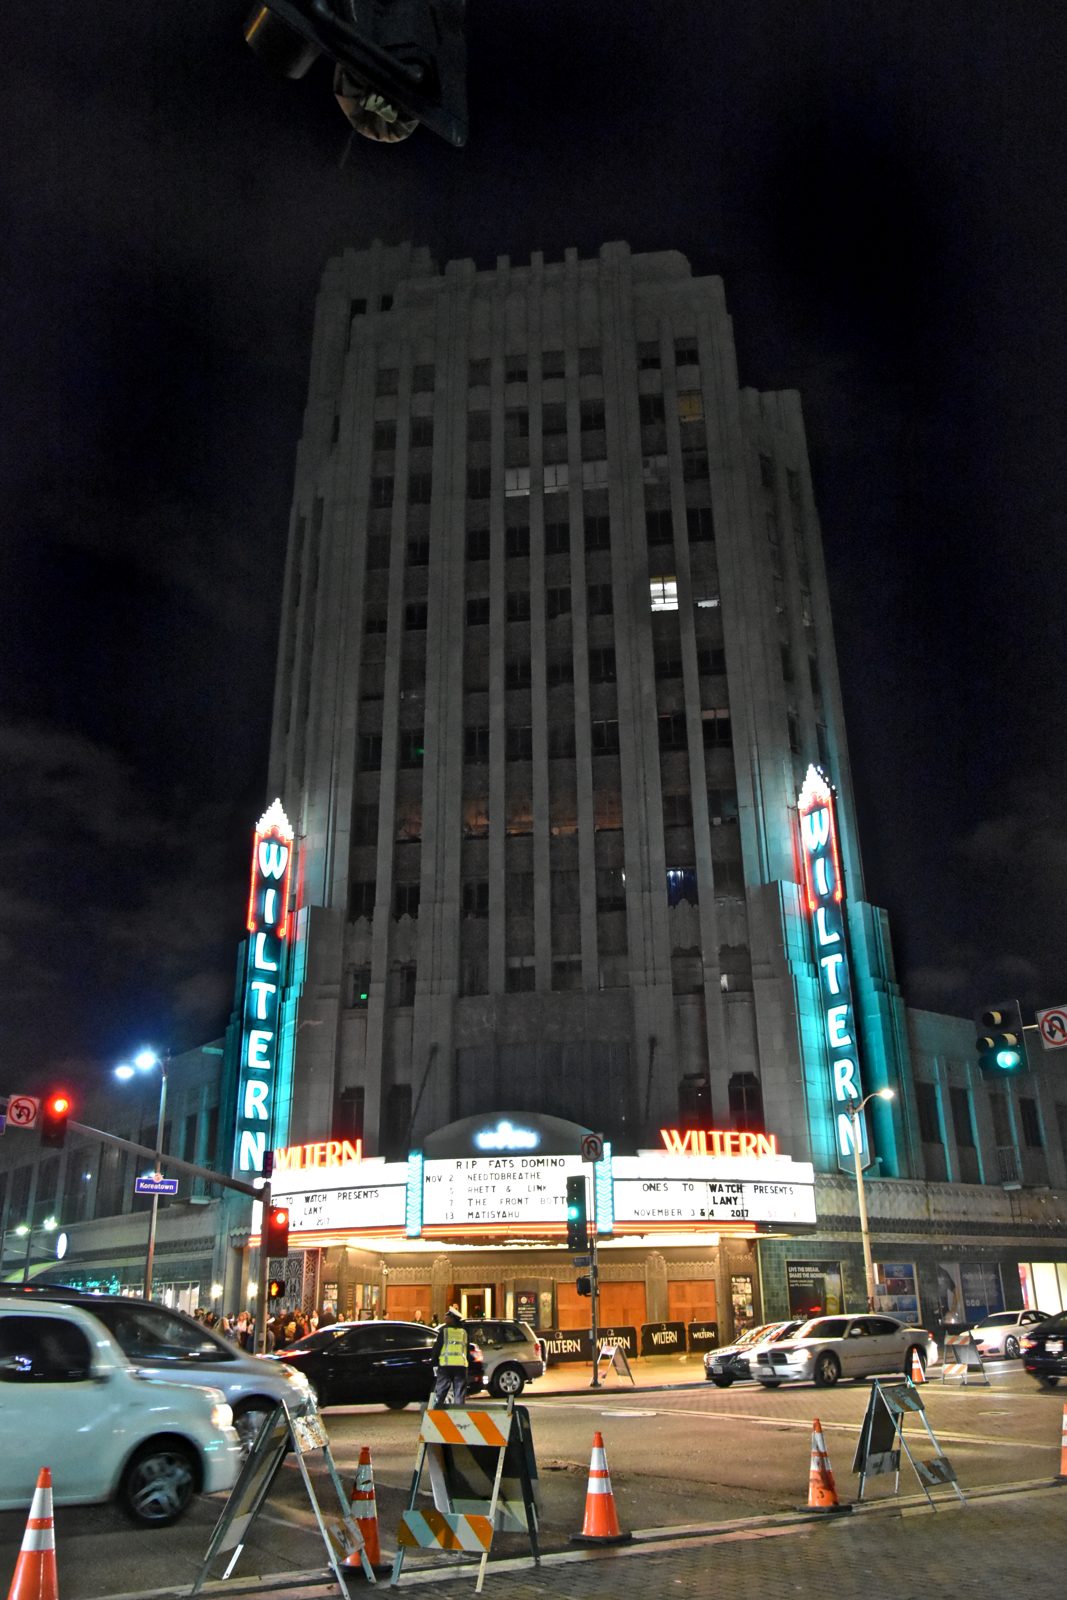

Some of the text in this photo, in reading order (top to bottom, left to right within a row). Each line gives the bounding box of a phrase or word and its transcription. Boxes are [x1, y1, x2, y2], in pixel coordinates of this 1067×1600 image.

[803, 807, 863, 1156] WILTERN
[239, 842, 288, 1172] WILTERN
[660, 1129, 776, 1158] WILTERN
[456, 1158, 566, 1170] RIP FATS DOMINO
[426, 1175, 443, 1183] NOV
[468, 1172, 541, 1181] NEEDTOBREATHE
[139, 1182, 174, 1190] Koreatown
[506, 1185, 511, 1193] &
[642, 1183, 794, 1195] ONES TO WATCH PRESENTS
[304, 1195, 327, 1203] WATCH
[337, 1190, 380, 1200] PRESENTS
[468, 1198, 487, 1206] THE
[499, 1197, 529, 1205] FRONT
[540, 1196, 567, 1205] BOTT
[712, 1196, 738, 1205] LANY
[445, 1211, 520, 1220] 13 MATISYAHU
[633, 1209, 683, 1217] NOVEMBER
[700, 1209, 706, 1217] &
[708, 1209, 715, 1217] 4
[731, 1209, 749, 1218] 2017
[651, 1330, 677, 1345] WILTERN
[692, 1331, 715, 1339] WILTERN
